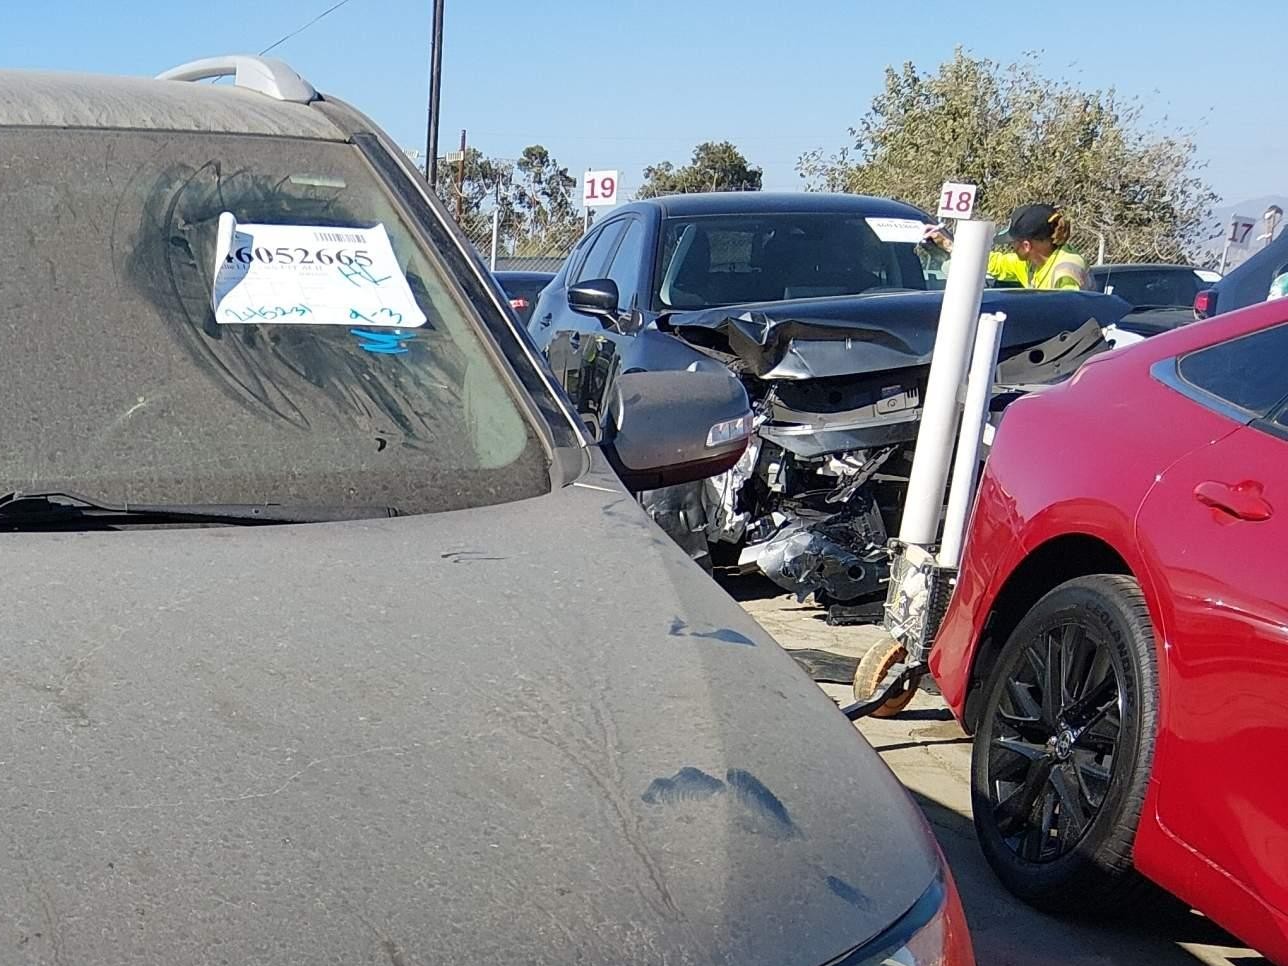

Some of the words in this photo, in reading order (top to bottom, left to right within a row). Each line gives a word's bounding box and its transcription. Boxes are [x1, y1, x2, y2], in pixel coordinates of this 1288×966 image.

[585, 177, 615, 199] 19
[941, 190, 972, 212] 18
[1227, 222, 1255, 244] 17
